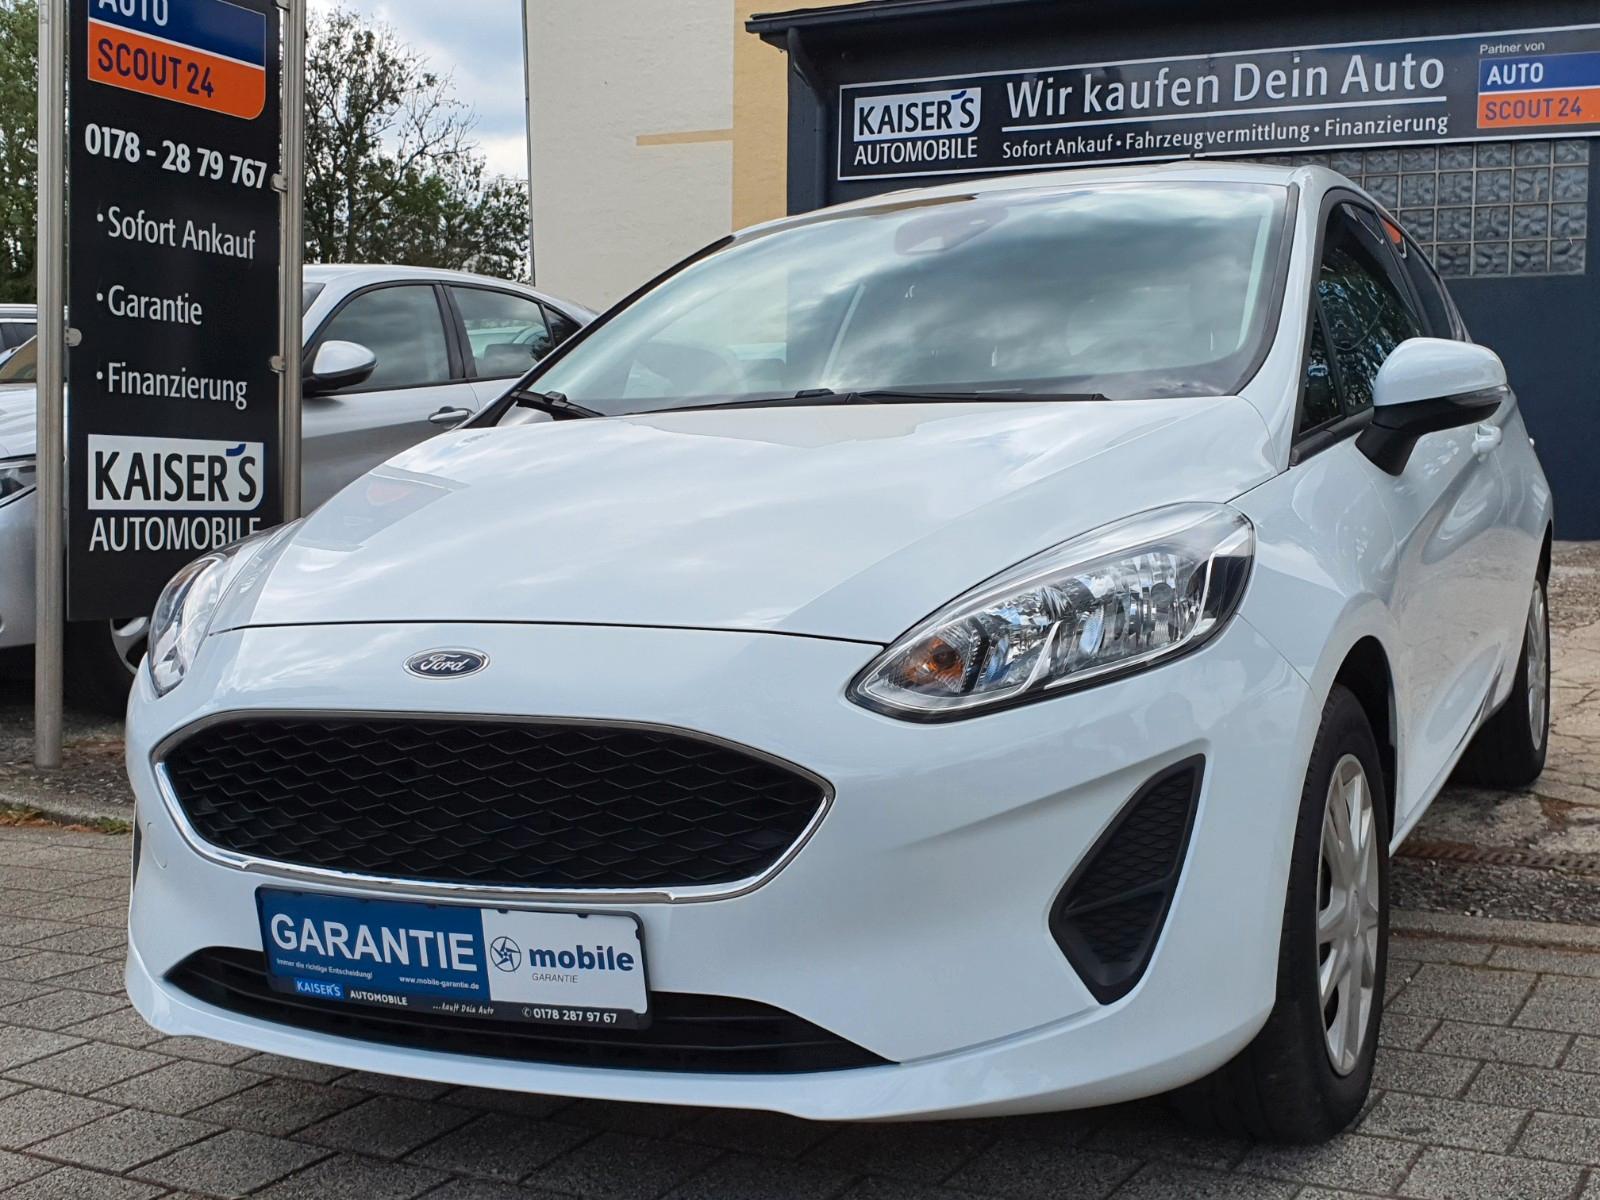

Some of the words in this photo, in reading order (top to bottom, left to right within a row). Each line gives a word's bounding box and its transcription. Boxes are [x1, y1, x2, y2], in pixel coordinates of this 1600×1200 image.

[1480, 43, 1521, 54] Partner
[1524, 42, 1545, 52] von
[1006, 77, 1072, 118] Wir
[1083, 67, 1218, 113] kaufen
[1234, 56, 1327, 102] Dein
[1340, 53, 1445, 94] Auto
[1486, 62, 1544, 86] AUTO
[1002, 140, 1052, 159] Sofort
[1055, 134, 1113, 157] Ankauf
[1125, 121, 1310, 151] Fahrzeugvermittlung
[1325, 114, 1449, 137] Finanzierung
[85, 123, 141, 163] 0178
[162, 140, 191, 174] 28
[197, 148, 223, 180] 79
[230, 155, 268, 189] 767
[854, 136, 978, 166] AUTOMOBILE
[108, 206, 176, 247] Sofort
[182, 220, 256, 260] Ankauf
[108, 285, 203, 325] Garantie
[108, 362, 248, 410] Finanzierung
[420, 653, 470, 671] Ford
[271, 913, 478, 972] GARANTIE
[295, 960, 305, 969] die
[529, 944, 634, 972] mobile
[398, 976, 480, 990] www.mobile-garantie.de
[532, 972, 579, 984] GARANTIE
[350, 990, 408, 1006] AUTOMOBILE
[533, 1008, 560, 1020] 0178
[562, 1010, 583, 1021] 287
[586, 1011, 601, 1023] 97
[603, 1012, 617, 1024] 67
